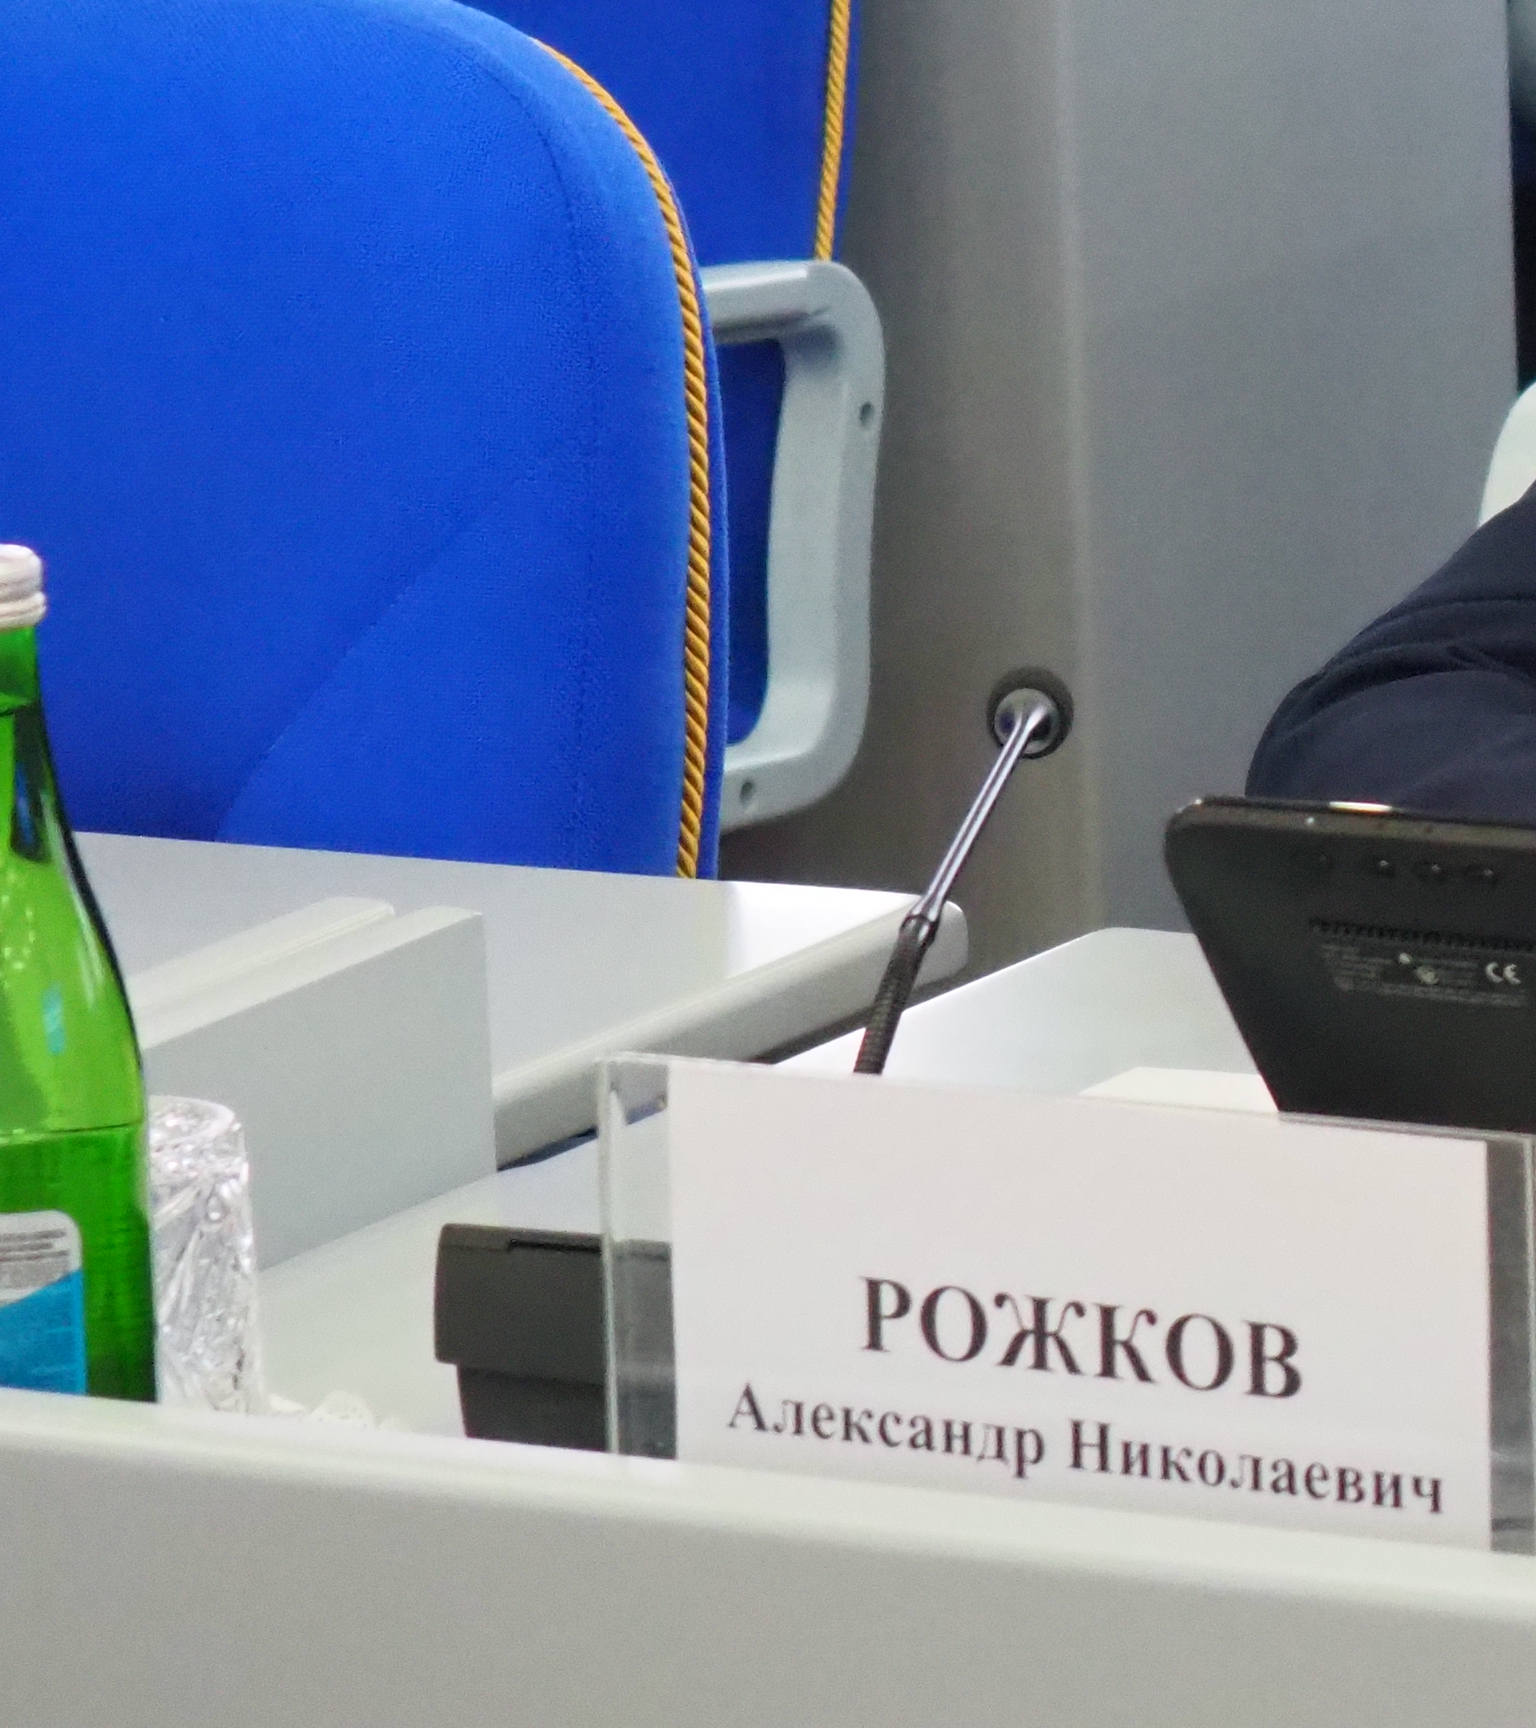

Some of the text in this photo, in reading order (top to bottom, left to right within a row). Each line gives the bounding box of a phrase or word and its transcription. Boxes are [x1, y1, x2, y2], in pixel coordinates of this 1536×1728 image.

[861, 1276, 1303, 1400] РОЖКОВ
[728, 1383, 1444, 1515] Александр Николаевич
